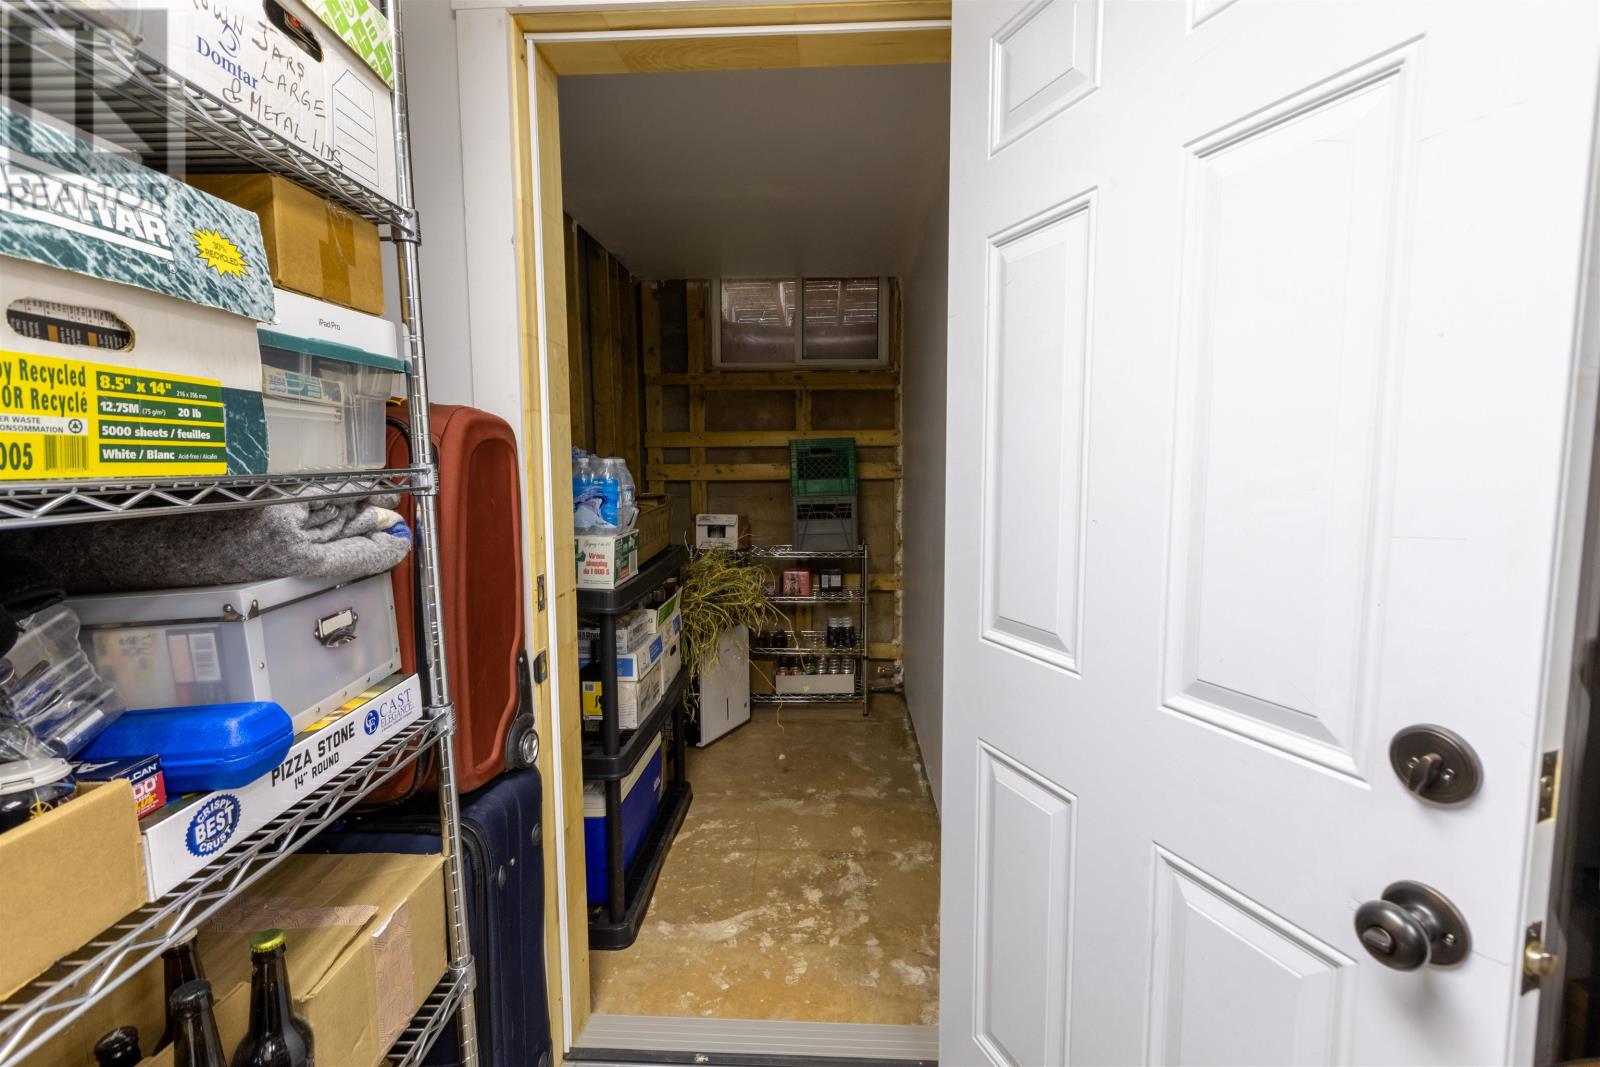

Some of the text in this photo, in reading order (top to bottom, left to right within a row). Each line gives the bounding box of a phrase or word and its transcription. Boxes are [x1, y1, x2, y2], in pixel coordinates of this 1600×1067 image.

[196, 35, 259, 90] Domtar
[261, 61, 325, 112] LARGE
[250, 91, 307, 144] METAL
[204, 248, 239, 267] RECYCLED
[318, 318, 341, 331] iPad Pro
[19, 358, 86, 390] Recycled
[136, 381, 147, 393] x
[30, 387, 88, 417] Recyclé
[100, 401, 139, 414] 12.75M
[178, 407, 190, 418] 20
[192, 408, 202, 418] lb
[11, 416, 41, 424] WASTE
[101, 425, 132, 436] 5000
[134, 426, 169, 438] sheets
[177, 428, 211, 440] feuilles
[102, 448, 136, 459] White
[146, 449, 175, 460] Blanc
[379, 687, 411, 718] CAST
[272, 748, 313, 787] PIZZA
[317, 721, 356, 758] STONE
[311, 752, 340, 778] ROUND
[197, 799, 231, 823] CRISPY
[195, 804, 235, 846] BEST
[199, 825, 231, 852] CRUST
